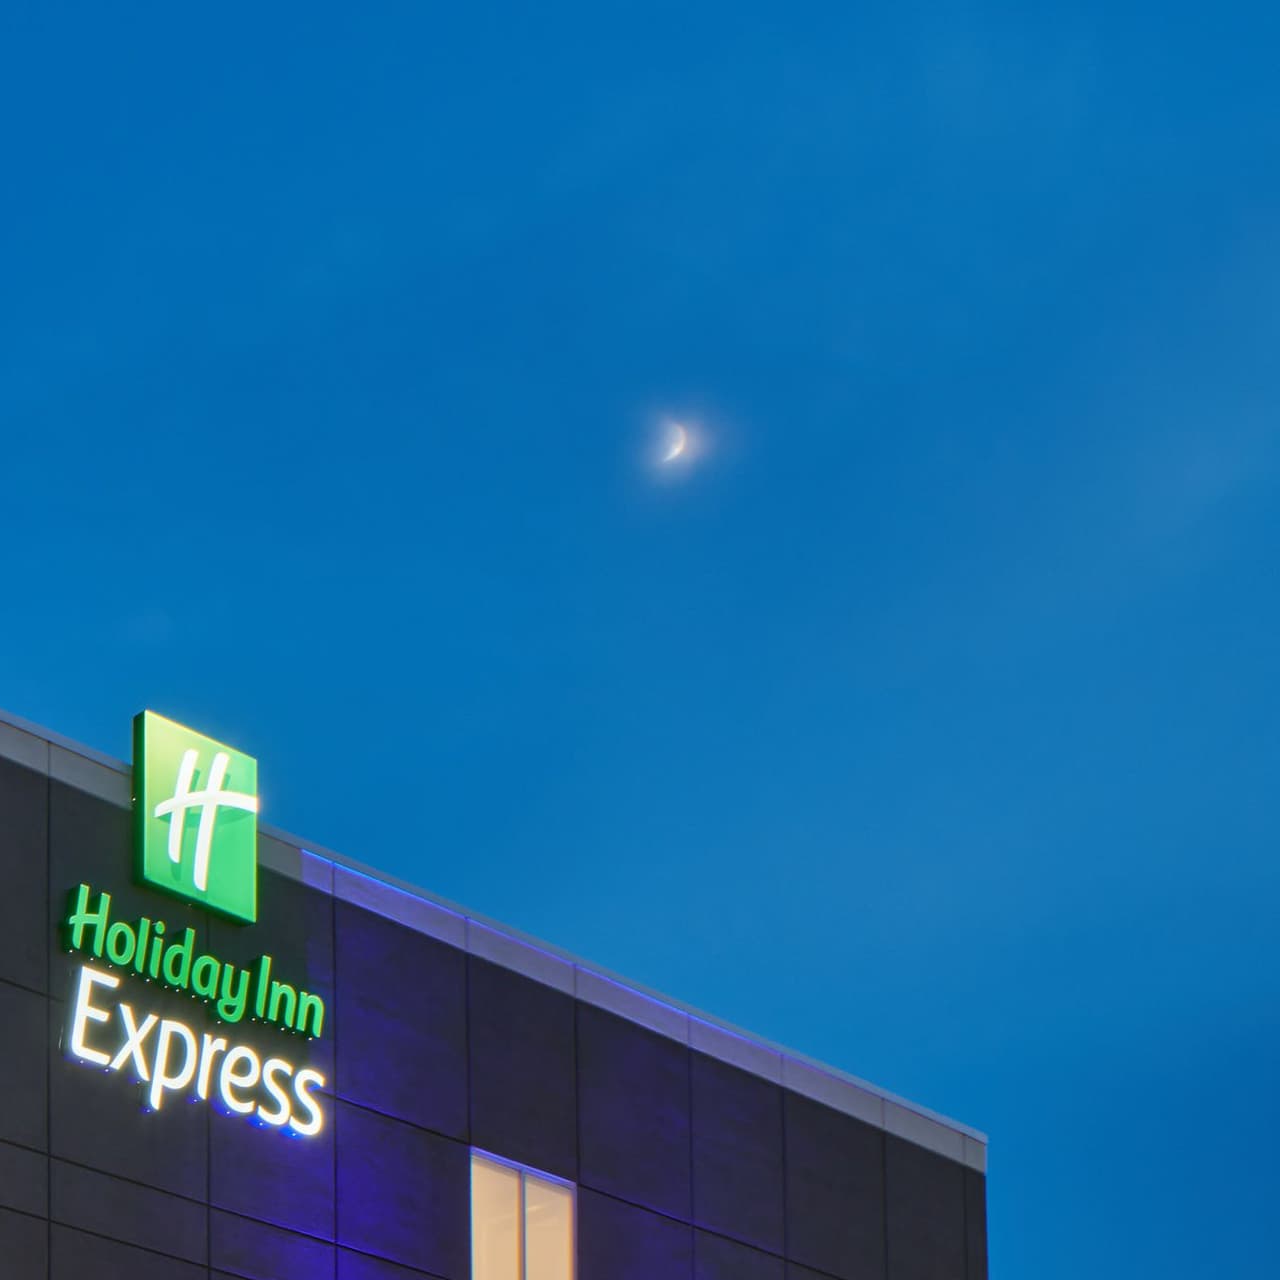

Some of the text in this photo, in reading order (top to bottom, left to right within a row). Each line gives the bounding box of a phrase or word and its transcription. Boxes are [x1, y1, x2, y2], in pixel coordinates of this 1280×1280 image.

[154, 749, 258, 892] H
[68, 883, 326, 1039] Holiday Inn
[70, 965, 326, 1138] Express
